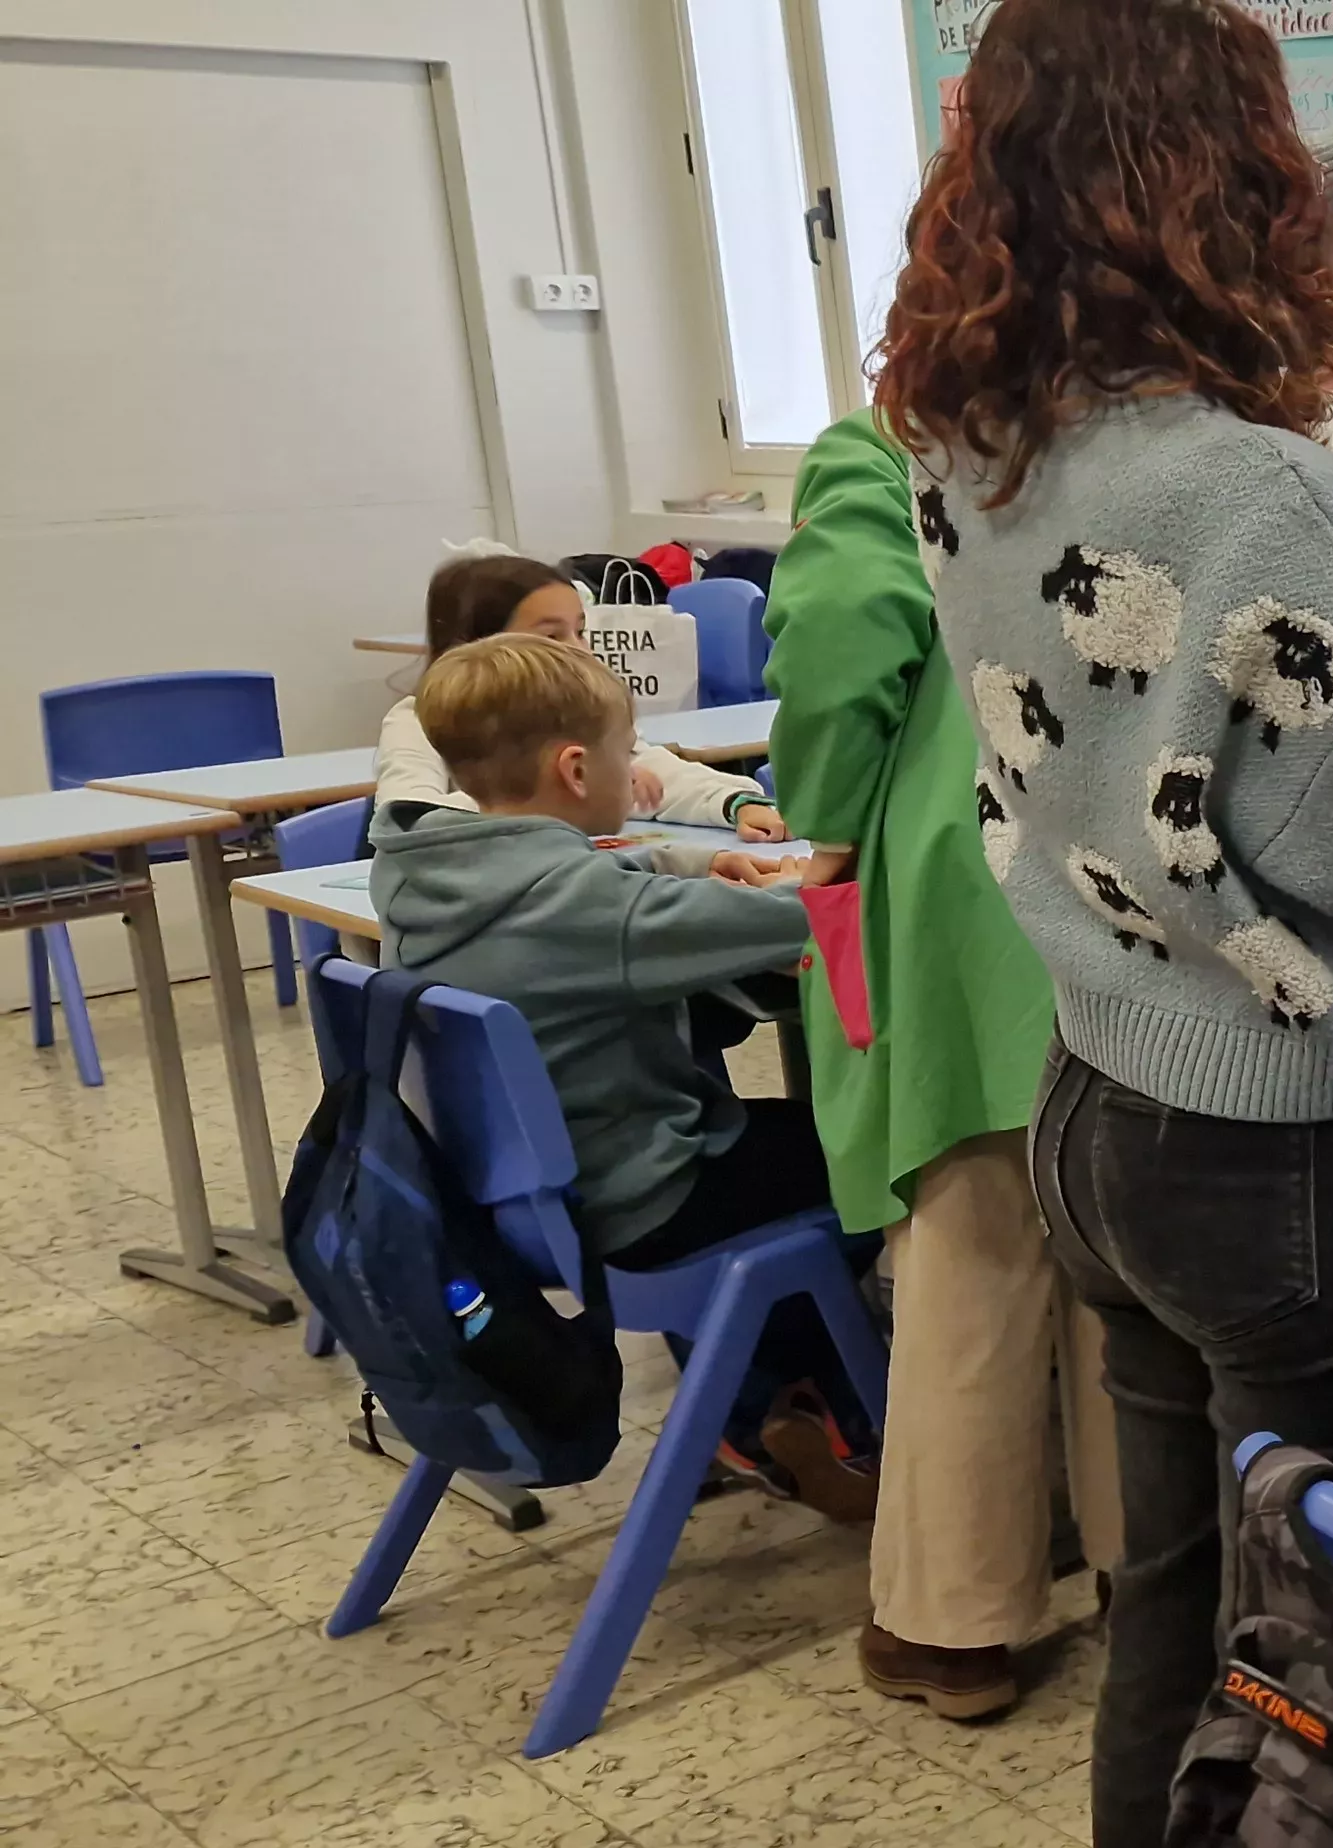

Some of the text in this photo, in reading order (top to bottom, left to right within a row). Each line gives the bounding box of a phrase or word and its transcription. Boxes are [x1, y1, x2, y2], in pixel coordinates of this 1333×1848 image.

[939, 27, 957, 50] DE
[590, 630, 656, 652] FERIA
[1223, 1671, 1329, 1749] DAKINE
